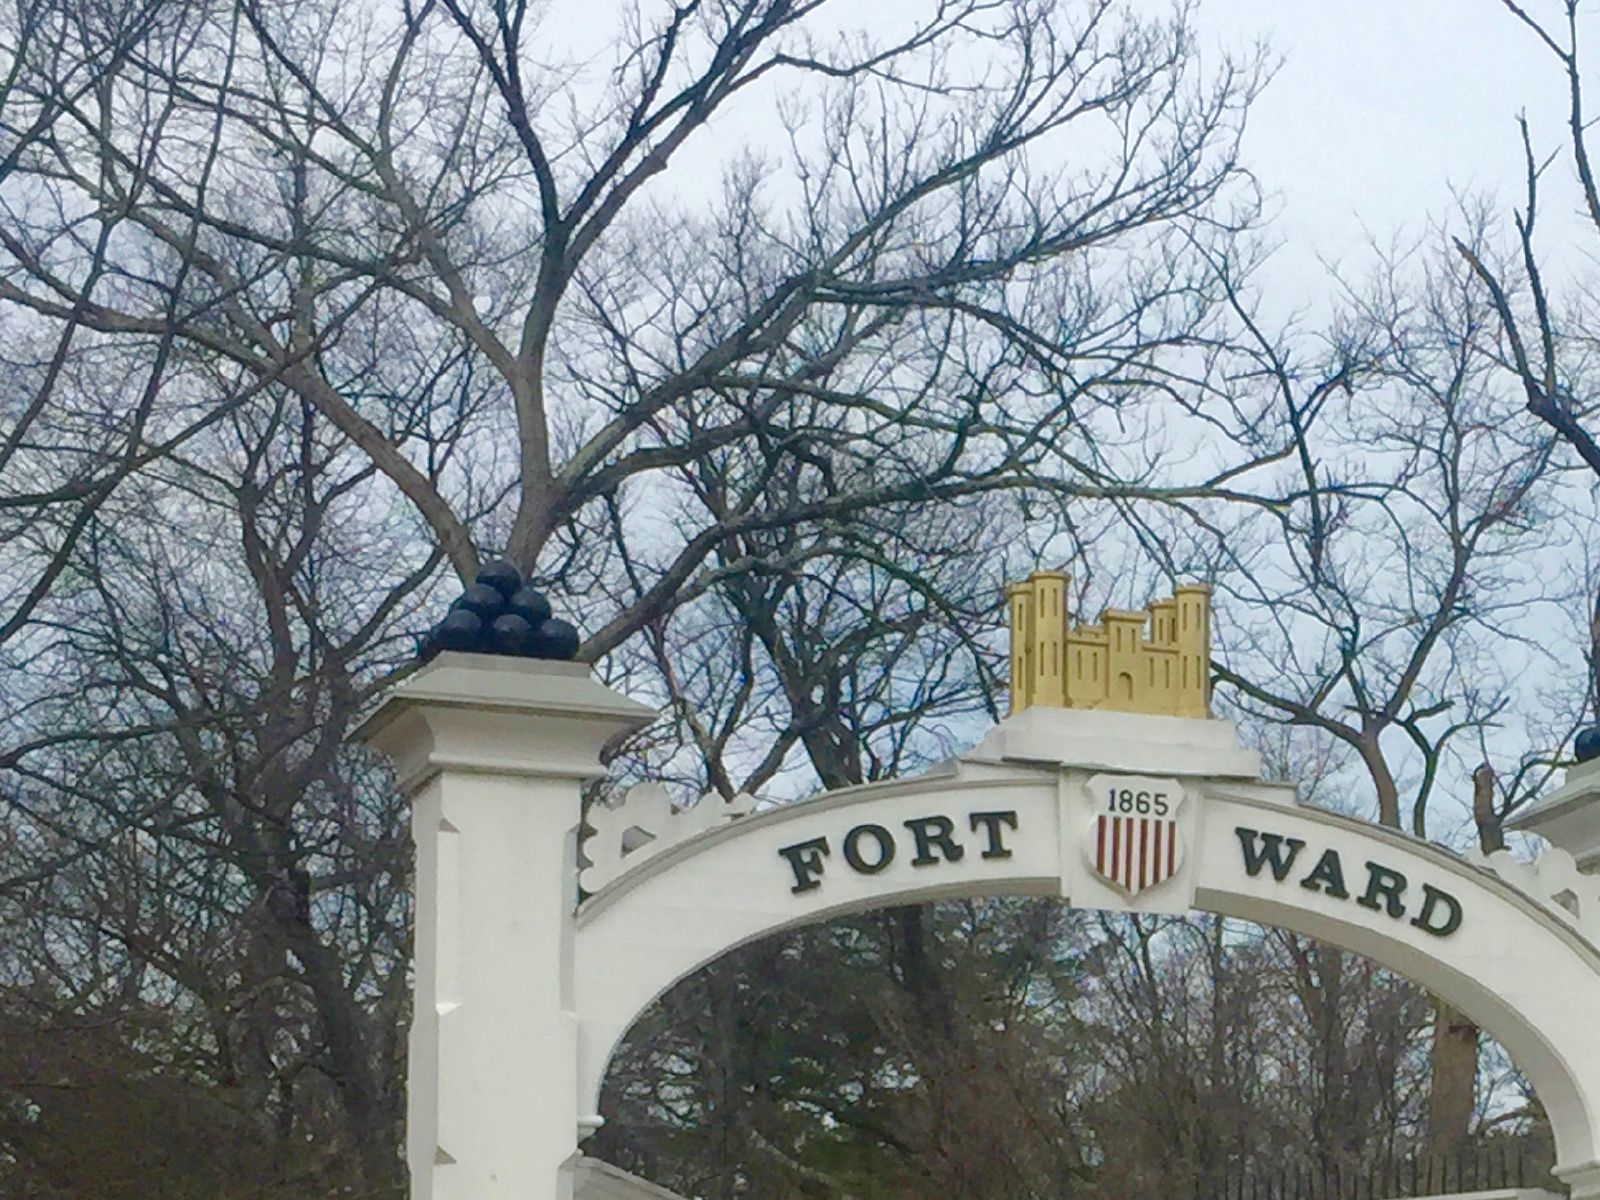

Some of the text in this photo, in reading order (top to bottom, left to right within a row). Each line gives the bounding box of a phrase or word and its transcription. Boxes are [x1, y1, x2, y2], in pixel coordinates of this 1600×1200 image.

[1108, 788, 1169, 816] 1865
[778, 810, 1463, 937] FORT WARD
